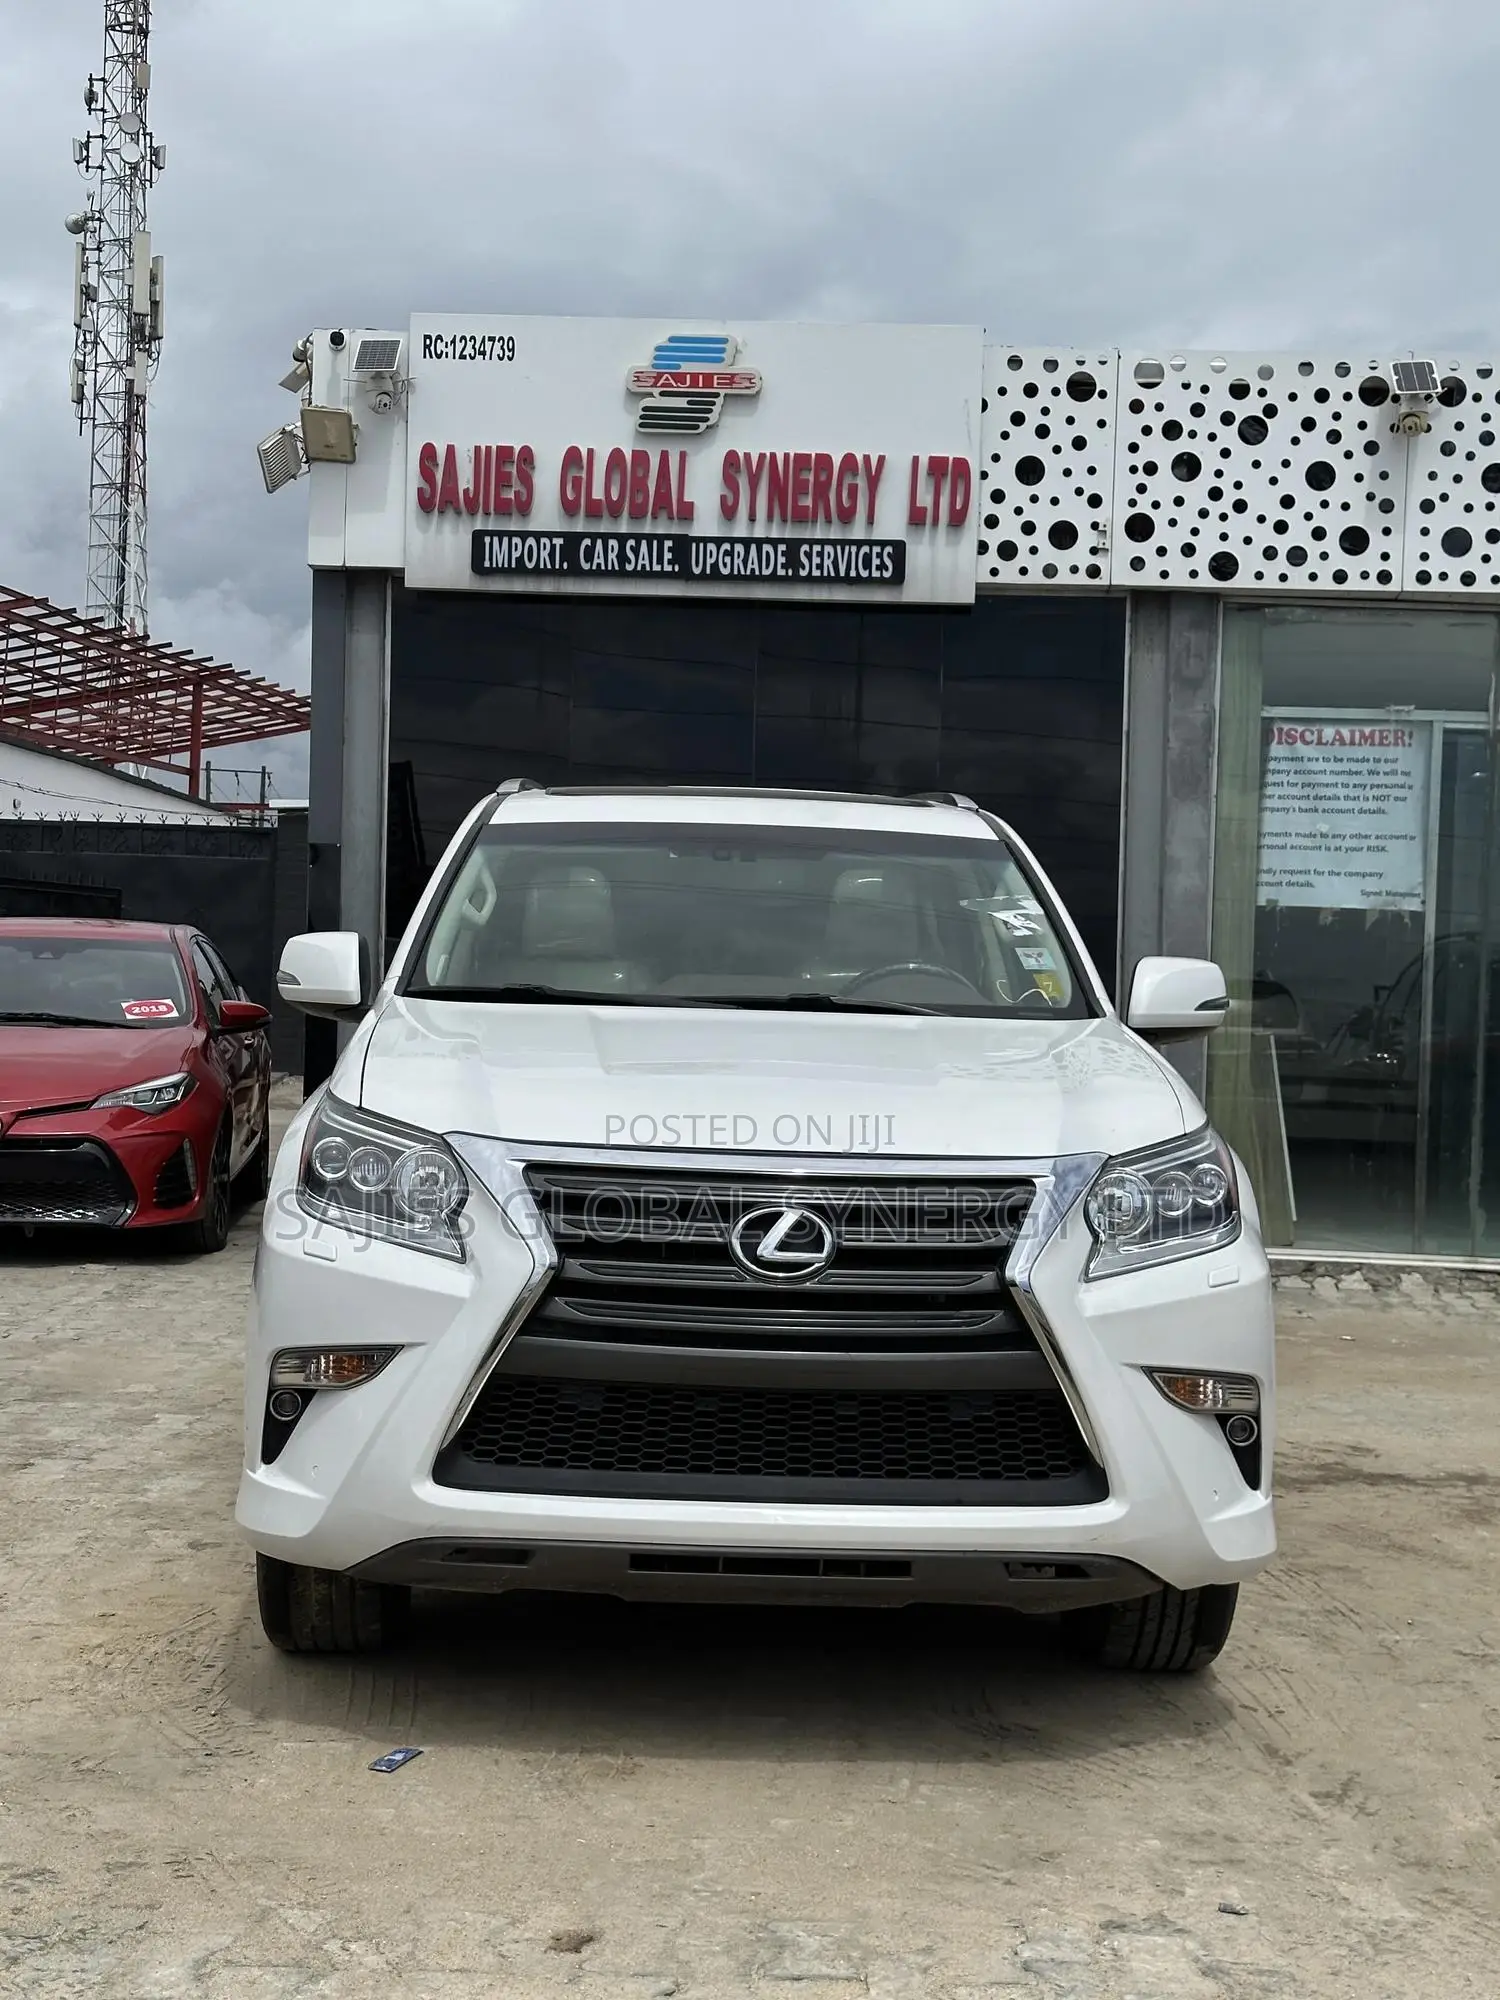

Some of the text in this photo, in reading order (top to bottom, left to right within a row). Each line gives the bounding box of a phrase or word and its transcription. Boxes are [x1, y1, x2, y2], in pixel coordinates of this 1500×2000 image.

[423, 334, 516, 361] RC:1234739
[633, 371, 756, 389] SAJIES
[417, 442, 972, 527] SAJIES GLOBAL SYNERGY LTD
[483, 535, 894, 578] IMPORT. CAR SALE. UPGRADE. SERVICES
[1322, 755, 1332, 763] to
[1333, 755, 1345, 763] be
[1346, 755, 1371, 764] made
[1373, 756, 1382, 764] to
[1367, 768, 1381, 776] We
[1383, 769, 1399, 777] will
[1287, 780, 1299, 788] for
[1301, 781, 1339, 790] payment
[1341, 781, 1350, 789] to
[1352, 783, 1368, 791] any
[1369, 782, 1406, 790] personal
[1277, 793, 1310, 801] account
[1312, 793, 1341, 801] details
[1343, 793, 1361, 801] that
[1372, 794, 1392, 802] NOT
[1298, 805, 1319, 813] bank
[1321, 806, 1356, 814] account
[1331, 833, 1347, 841] any
[1349, 832, 1372, 840] other
[1324, 843, 1331, 851] is
[1279, 868, 1311, 876] request
[1313, 868, 1326, 876] for
[1327, 868, 1342, 877] the
[1343, 870, 1384, 879] company
[131, 1004, 168, 1014] 2018
